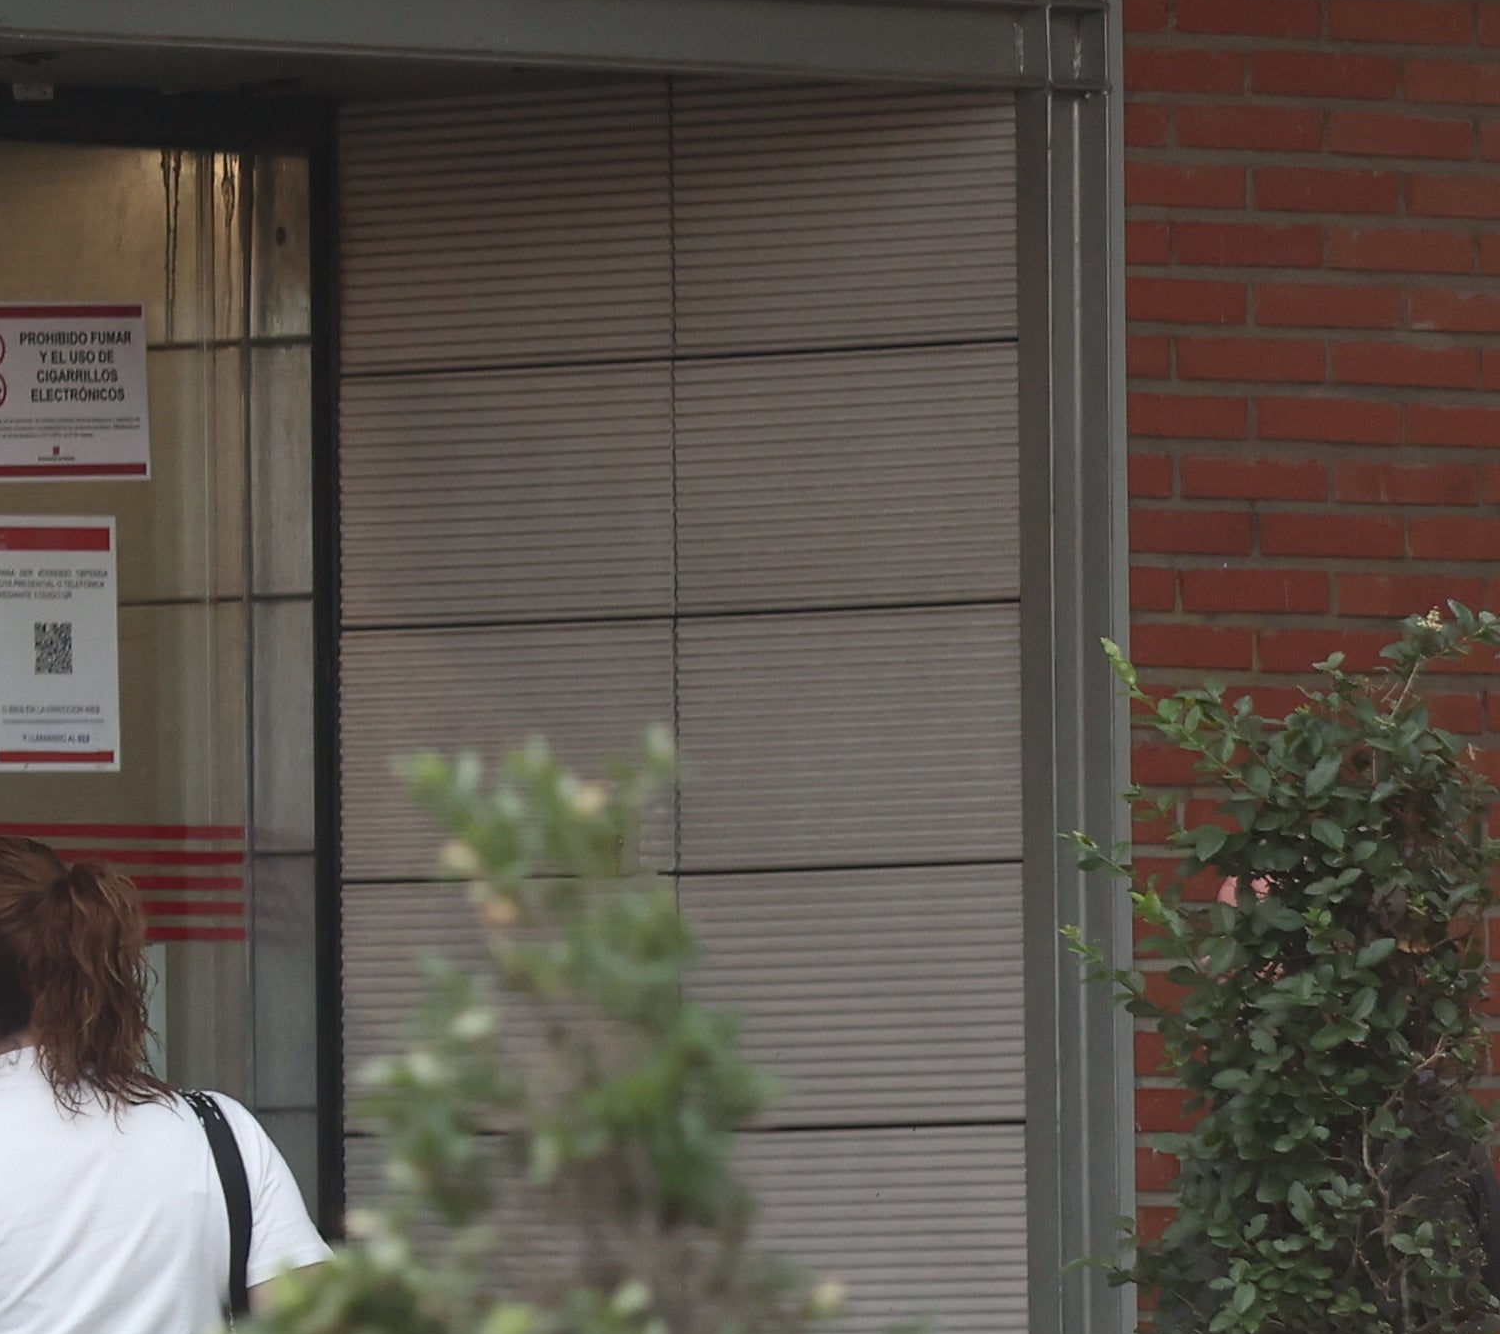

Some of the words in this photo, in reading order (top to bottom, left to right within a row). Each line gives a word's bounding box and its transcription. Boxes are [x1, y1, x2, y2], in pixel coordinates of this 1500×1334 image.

[20, 332, 87, 345] PROHIBIDO
[91, 331, 131, 345] FUMAR
[40, 351, 47, 363] Y
[51, 351, 66, 363] EL
[69, 350, 94, 363] USO
[98, 350, 114, 363] DE
[37, 369, 118, 383] CIGARRILLOS
[31, 387, 125, 402] ELECTRÓNICOS
